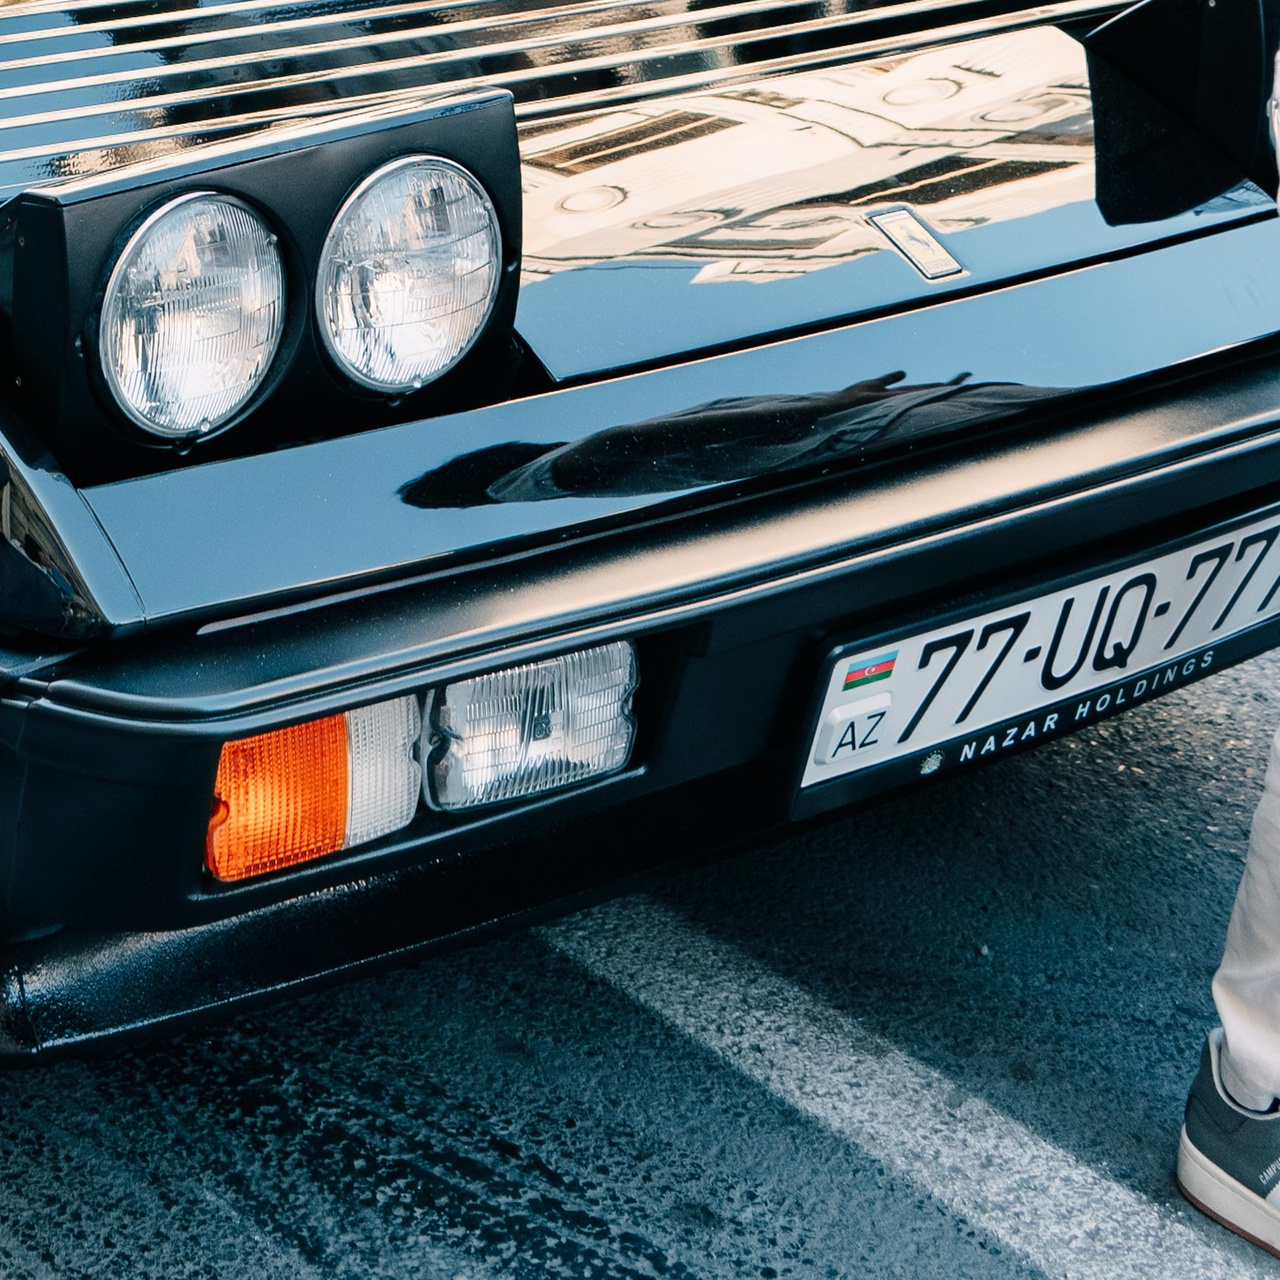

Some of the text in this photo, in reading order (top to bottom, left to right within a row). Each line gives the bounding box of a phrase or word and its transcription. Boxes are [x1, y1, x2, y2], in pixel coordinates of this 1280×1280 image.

[960, 650, 1215, 762] NAZAR HOLDINGS
[831, 709, 887, 758] AZ
[1259, 1157, 1280, 1185] CAMPU
